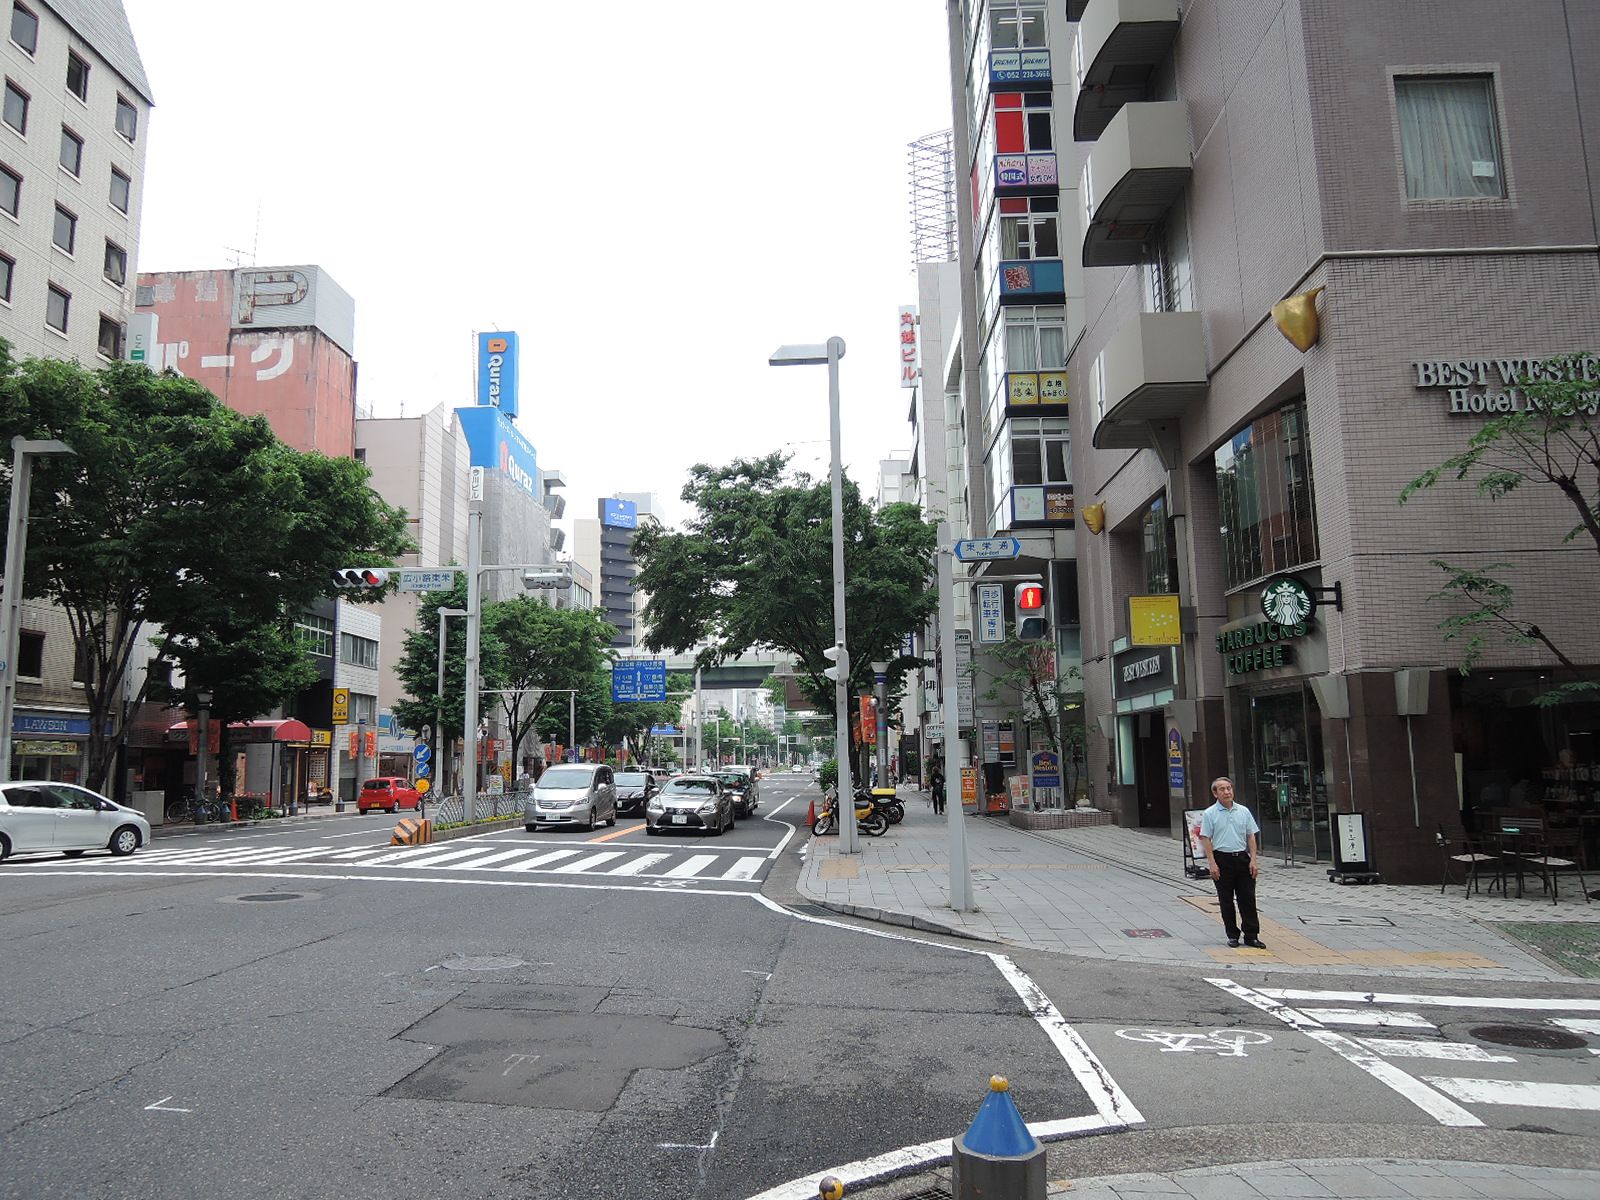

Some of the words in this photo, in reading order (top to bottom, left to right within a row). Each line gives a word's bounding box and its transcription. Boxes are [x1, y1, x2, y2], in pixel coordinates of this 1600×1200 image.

[238, 271, 309, 324] P
[487, 354, 504, 407] Quraz
[1413, 360, 1489, 387] BEST
[1449, 388, 1520, 414] Hotel
[508, 454, 533, 493] Quraz
[403, 573, 451, 583] 広小路東栄
[1215, 620, 1309, 655] STARBUCKS
[1226, 644, 1283, 676] COFFEE
[24, 719, 68, 731] LAWSON
